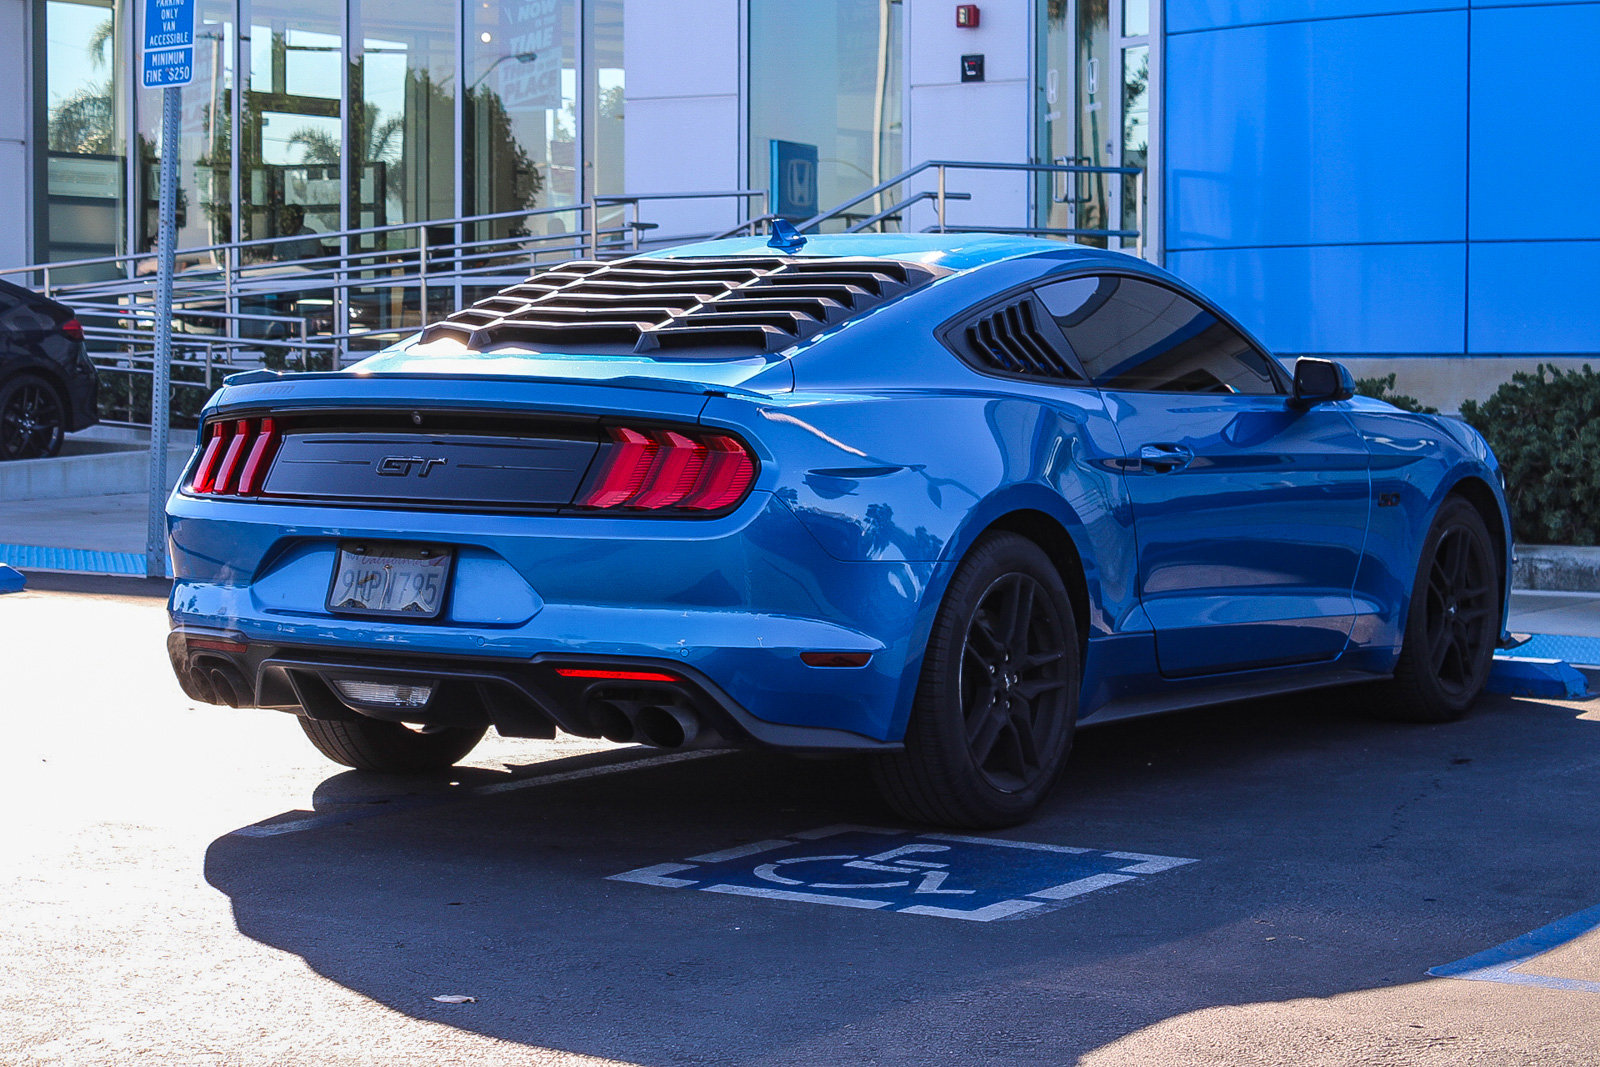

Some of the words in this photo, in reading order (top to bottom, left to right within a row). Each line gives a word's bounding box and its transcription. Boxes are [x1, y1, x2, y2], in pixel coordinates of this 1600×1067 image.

[161, 8, 179, 20] ONLY
[162, 21, 176, 32] VAN
[150, 32, 189, 47] ACCESSIBLE
[152, 51, 185, 66] MINIMUM
[146, 69, 163, 83] FINE
[167, 66, 190, 81] $250
[375, 455, 448, 478] GT
